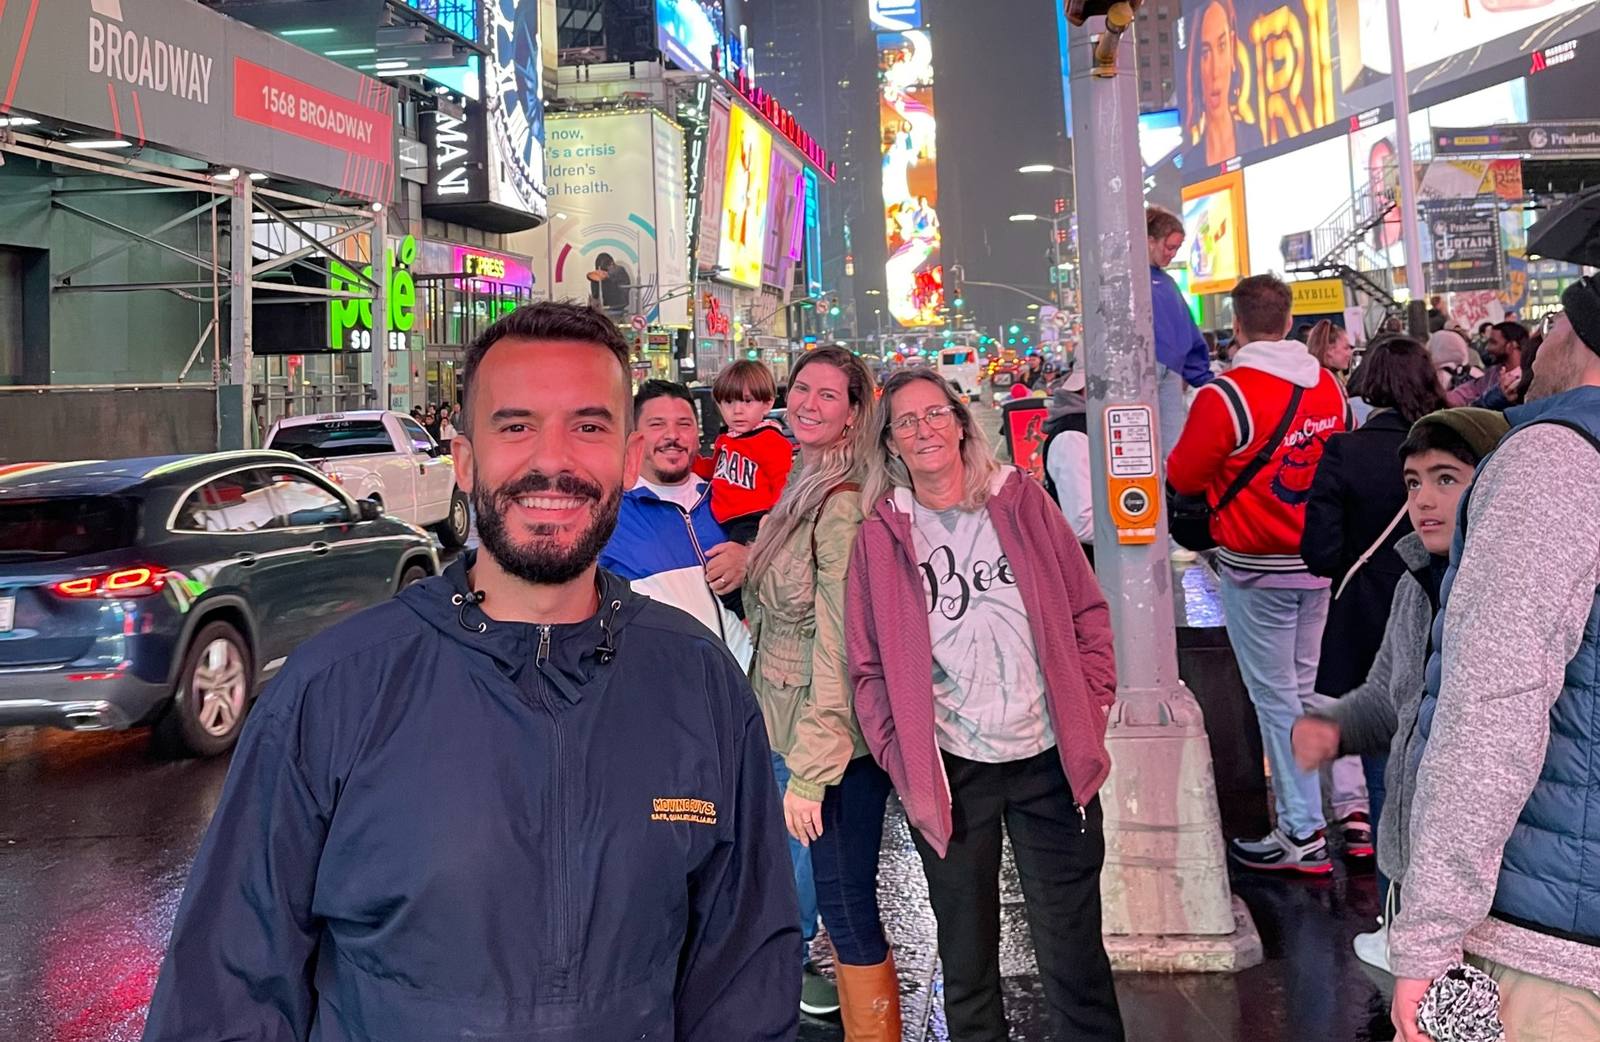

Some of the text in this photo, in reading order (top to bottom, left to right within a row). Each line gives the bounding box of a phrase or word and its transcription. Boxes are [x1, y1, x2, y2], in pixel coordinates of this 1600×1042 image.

[89, 17, 213, 104] BROADWAY
[262, 86, 374, 144] 1568 BROADWAY
[563, 148, 572, 158] a
[576, 143, 616, 157] crisis
[564, 180, 614, 195] health.
[1435, 236, 1492, 250] CURTAIN
[1436, 248, 1455, 261] UP
[1294, 287, 1339, 301] AYBILL
[350, 329, 407, 351] SOER
[1303, 415, 1338, 437] Crew
[918, 545, 1017, 620] Boo
[653, 798, 690, 813] MOVING
